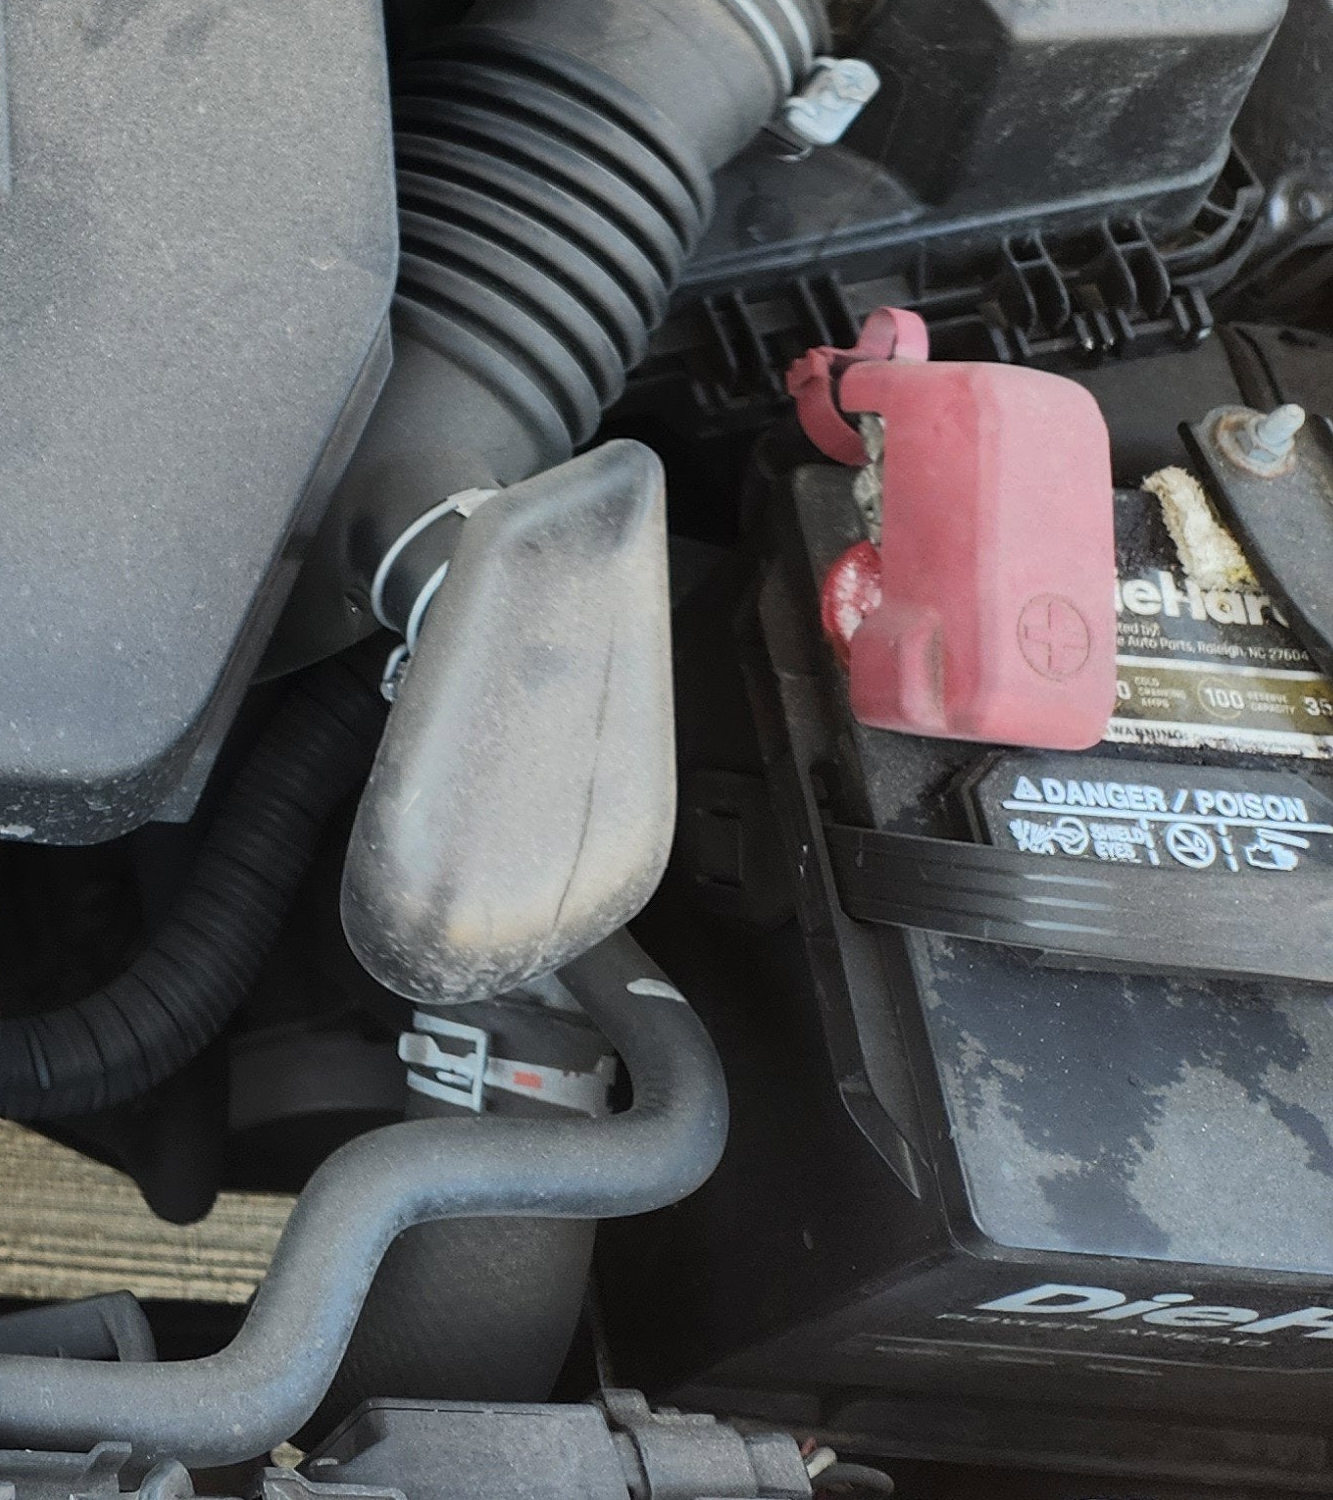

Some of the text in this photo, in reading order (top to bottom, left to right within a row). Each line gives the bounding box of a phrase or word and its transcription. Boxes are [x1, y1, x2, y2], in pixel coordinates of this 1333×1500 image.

[1127, 635, 1158, 649] Auto
[1248, 646, 1267, 660] NC
[1204, 687, 1245, 710] 100
[1041, 777, 1168, 812] DANGER
[1192, 788, 1309, 823] POISON
[1089, 822, 1145, 845] SHIELD
